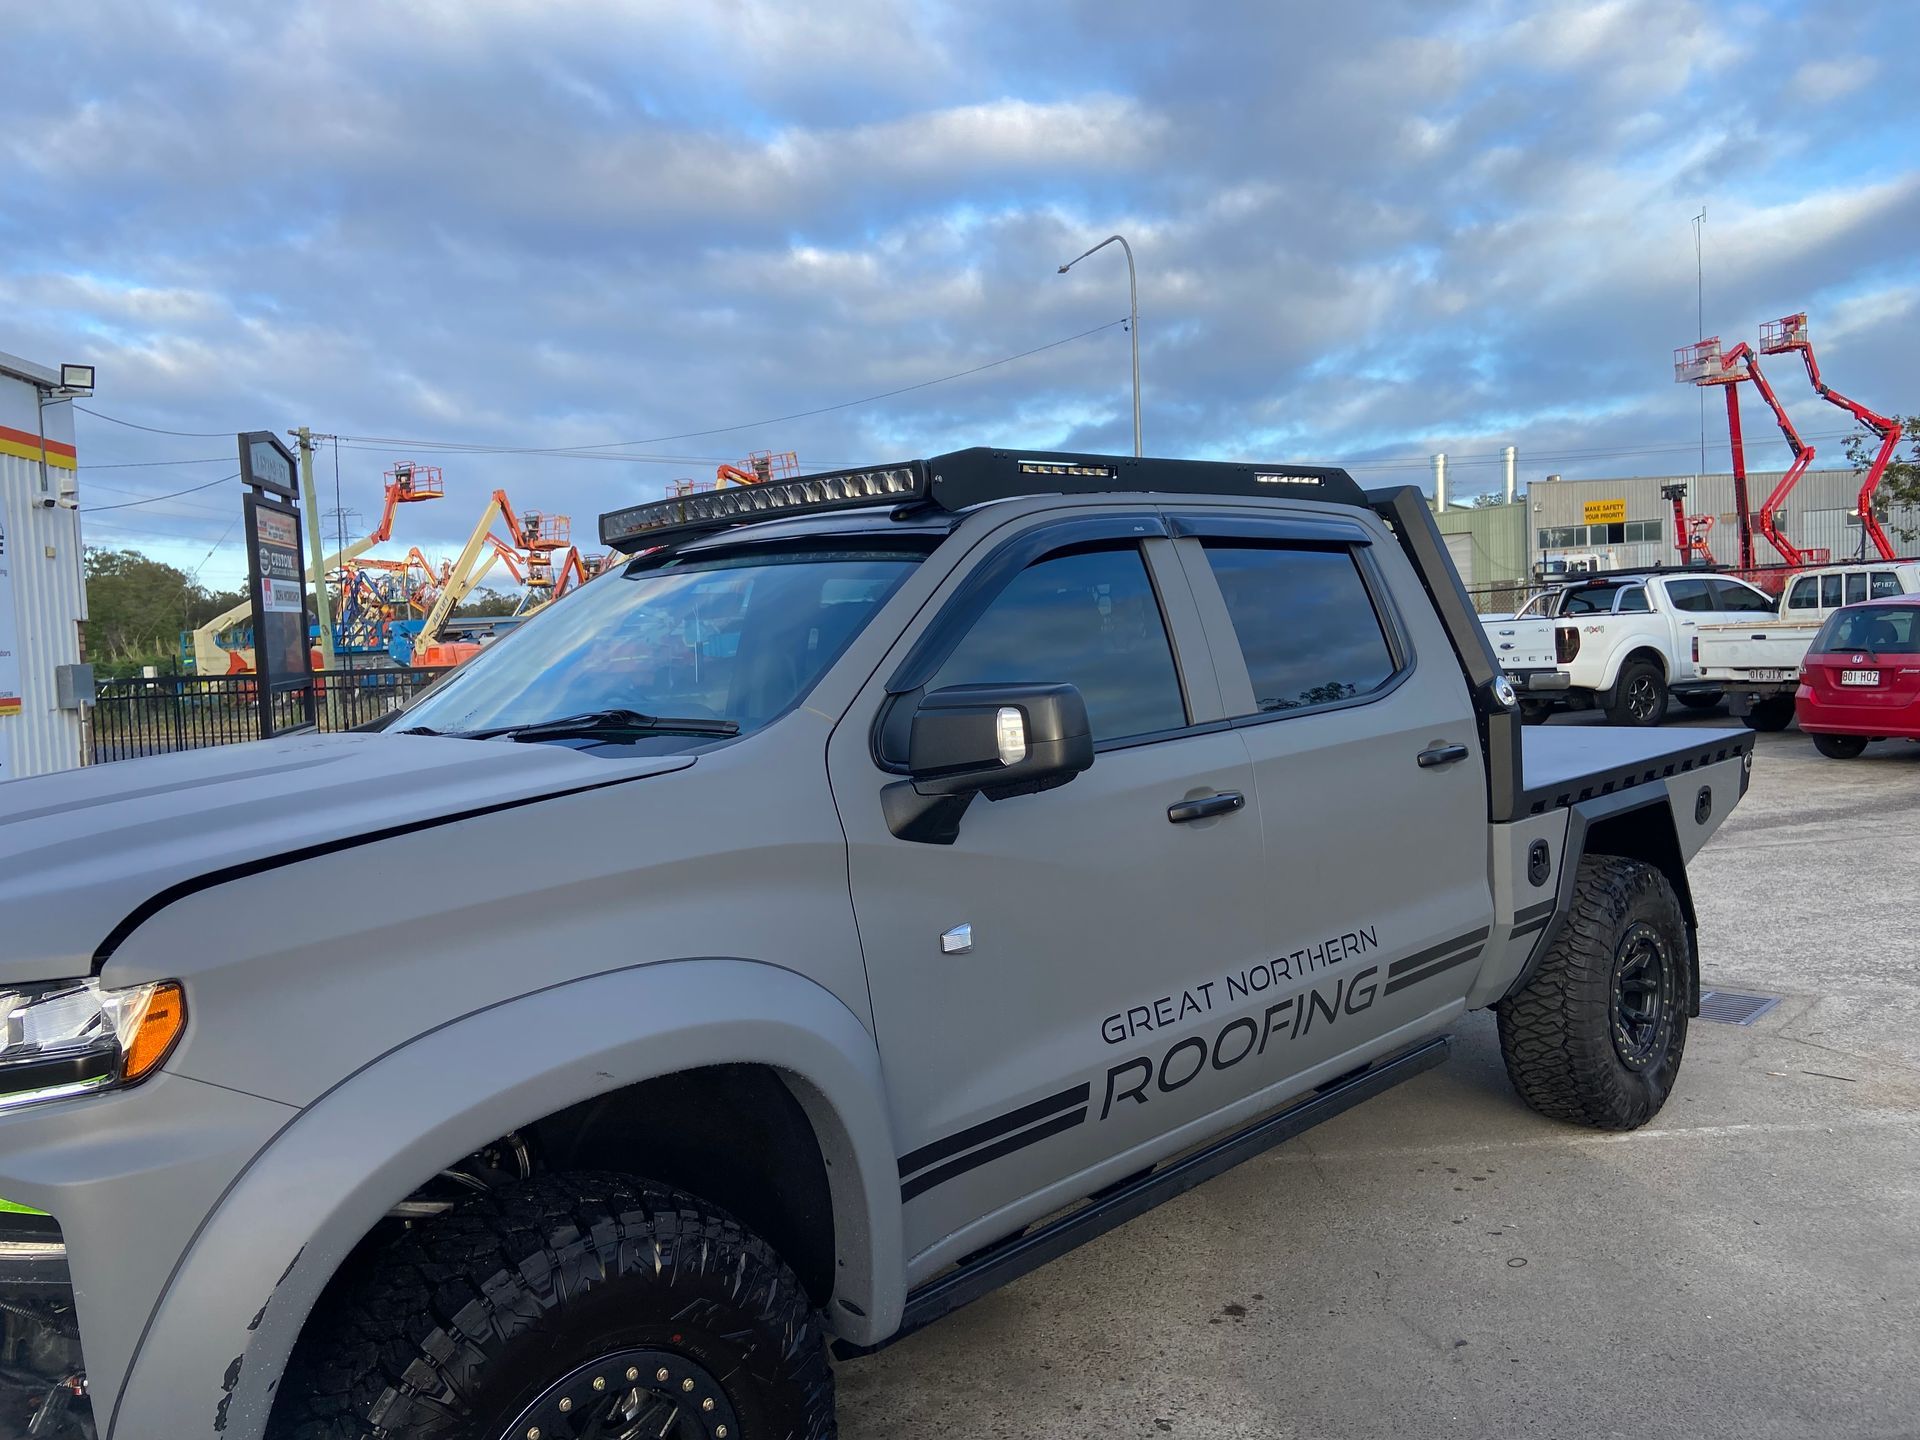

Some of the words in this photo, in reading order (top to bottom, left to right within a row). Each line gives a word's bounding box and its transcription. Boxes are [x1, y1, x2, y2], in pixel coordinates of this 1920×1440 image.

[1584, 505, 1601, 513] MAKE
[1603, 503, 1624, 511] SAFETY
[1600, 512, 1624, 520] PRIORITY
[271, 552, 293, 569] CUSTOM
[1101, 981, 1215, 1045] GREAT
[1226, 925, 1379, 1001] NORTHERN
[1099, 965, 1379, 1122] ROOFING
